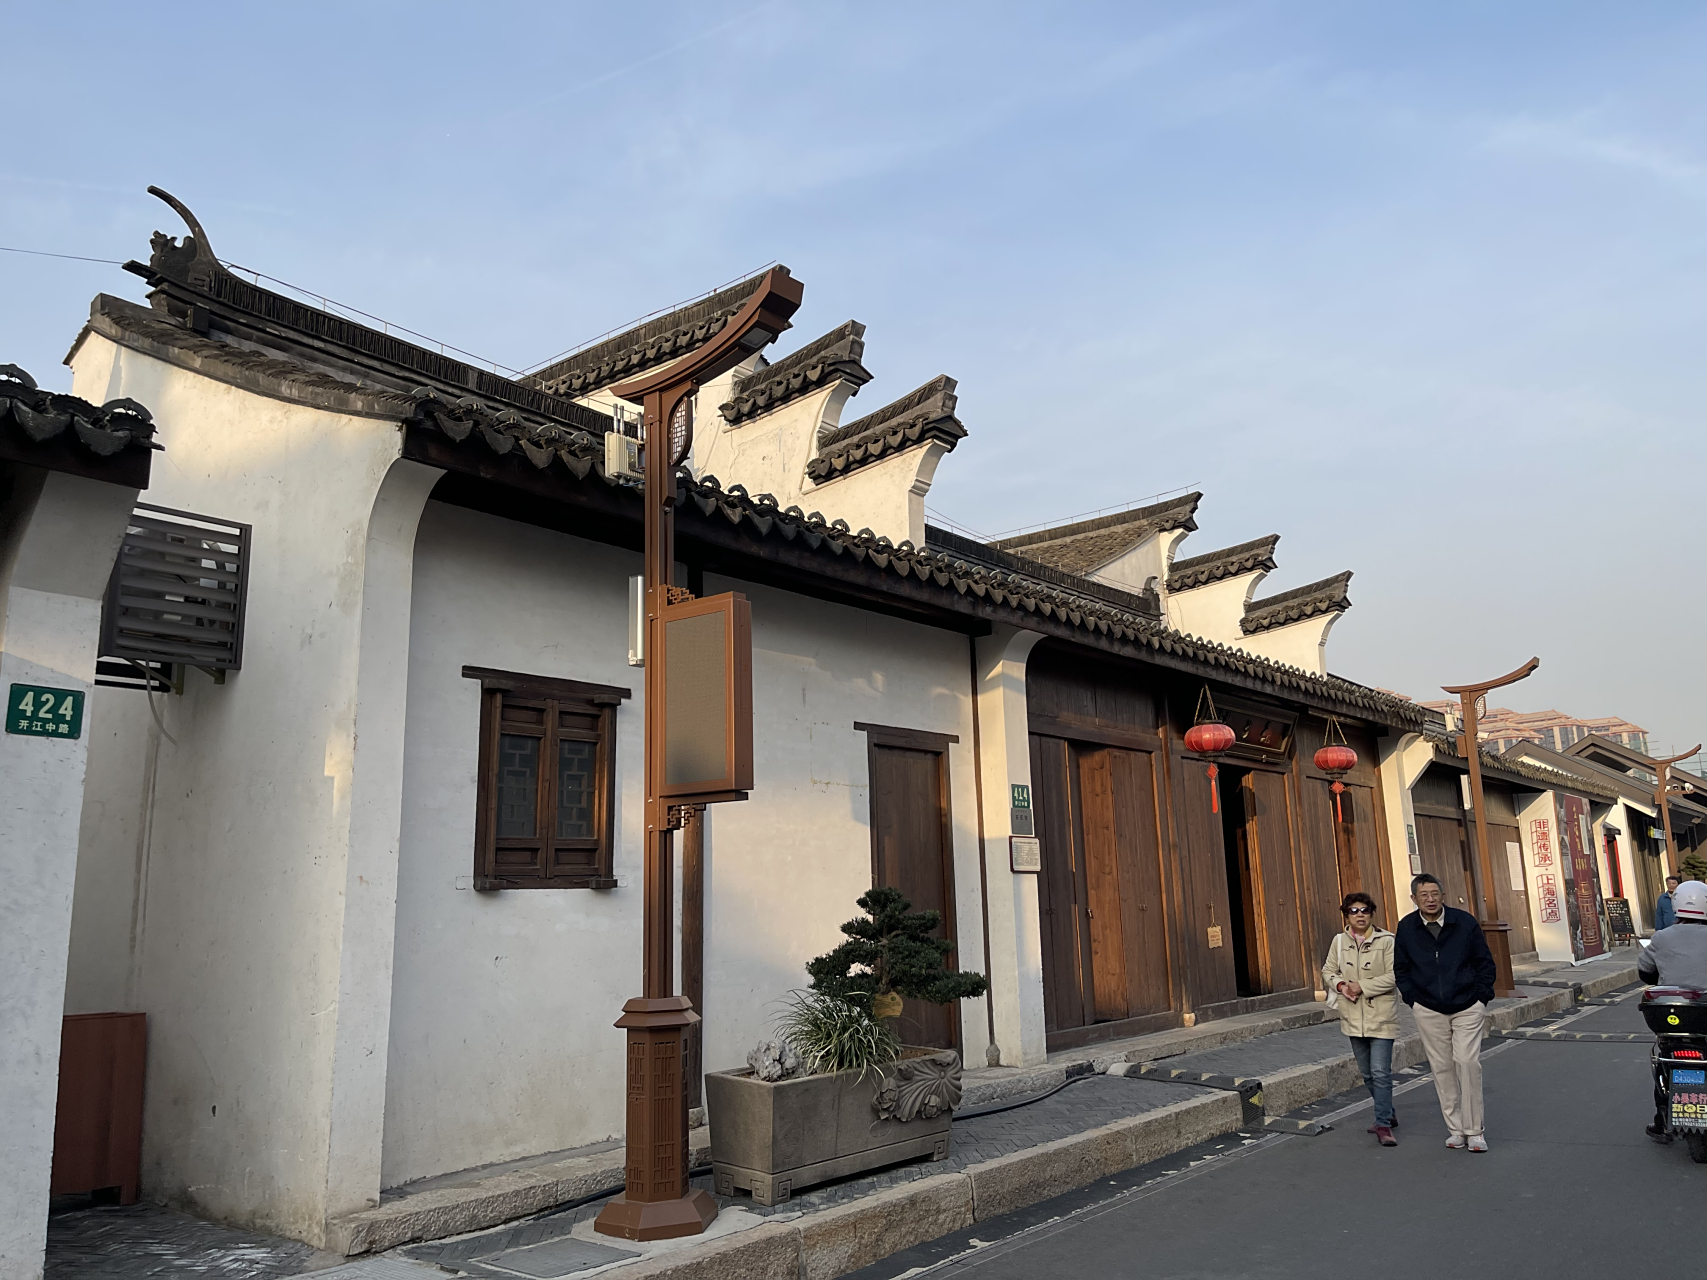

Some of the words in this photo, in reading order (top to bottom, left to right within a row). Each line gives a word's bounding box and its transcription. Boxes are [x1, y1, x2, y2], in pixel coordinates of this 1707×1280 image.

[18, 691, 74, 721] 424
[18, 720, 70, 734] 开江中路
[1014, 787, 1028, 800] 414
